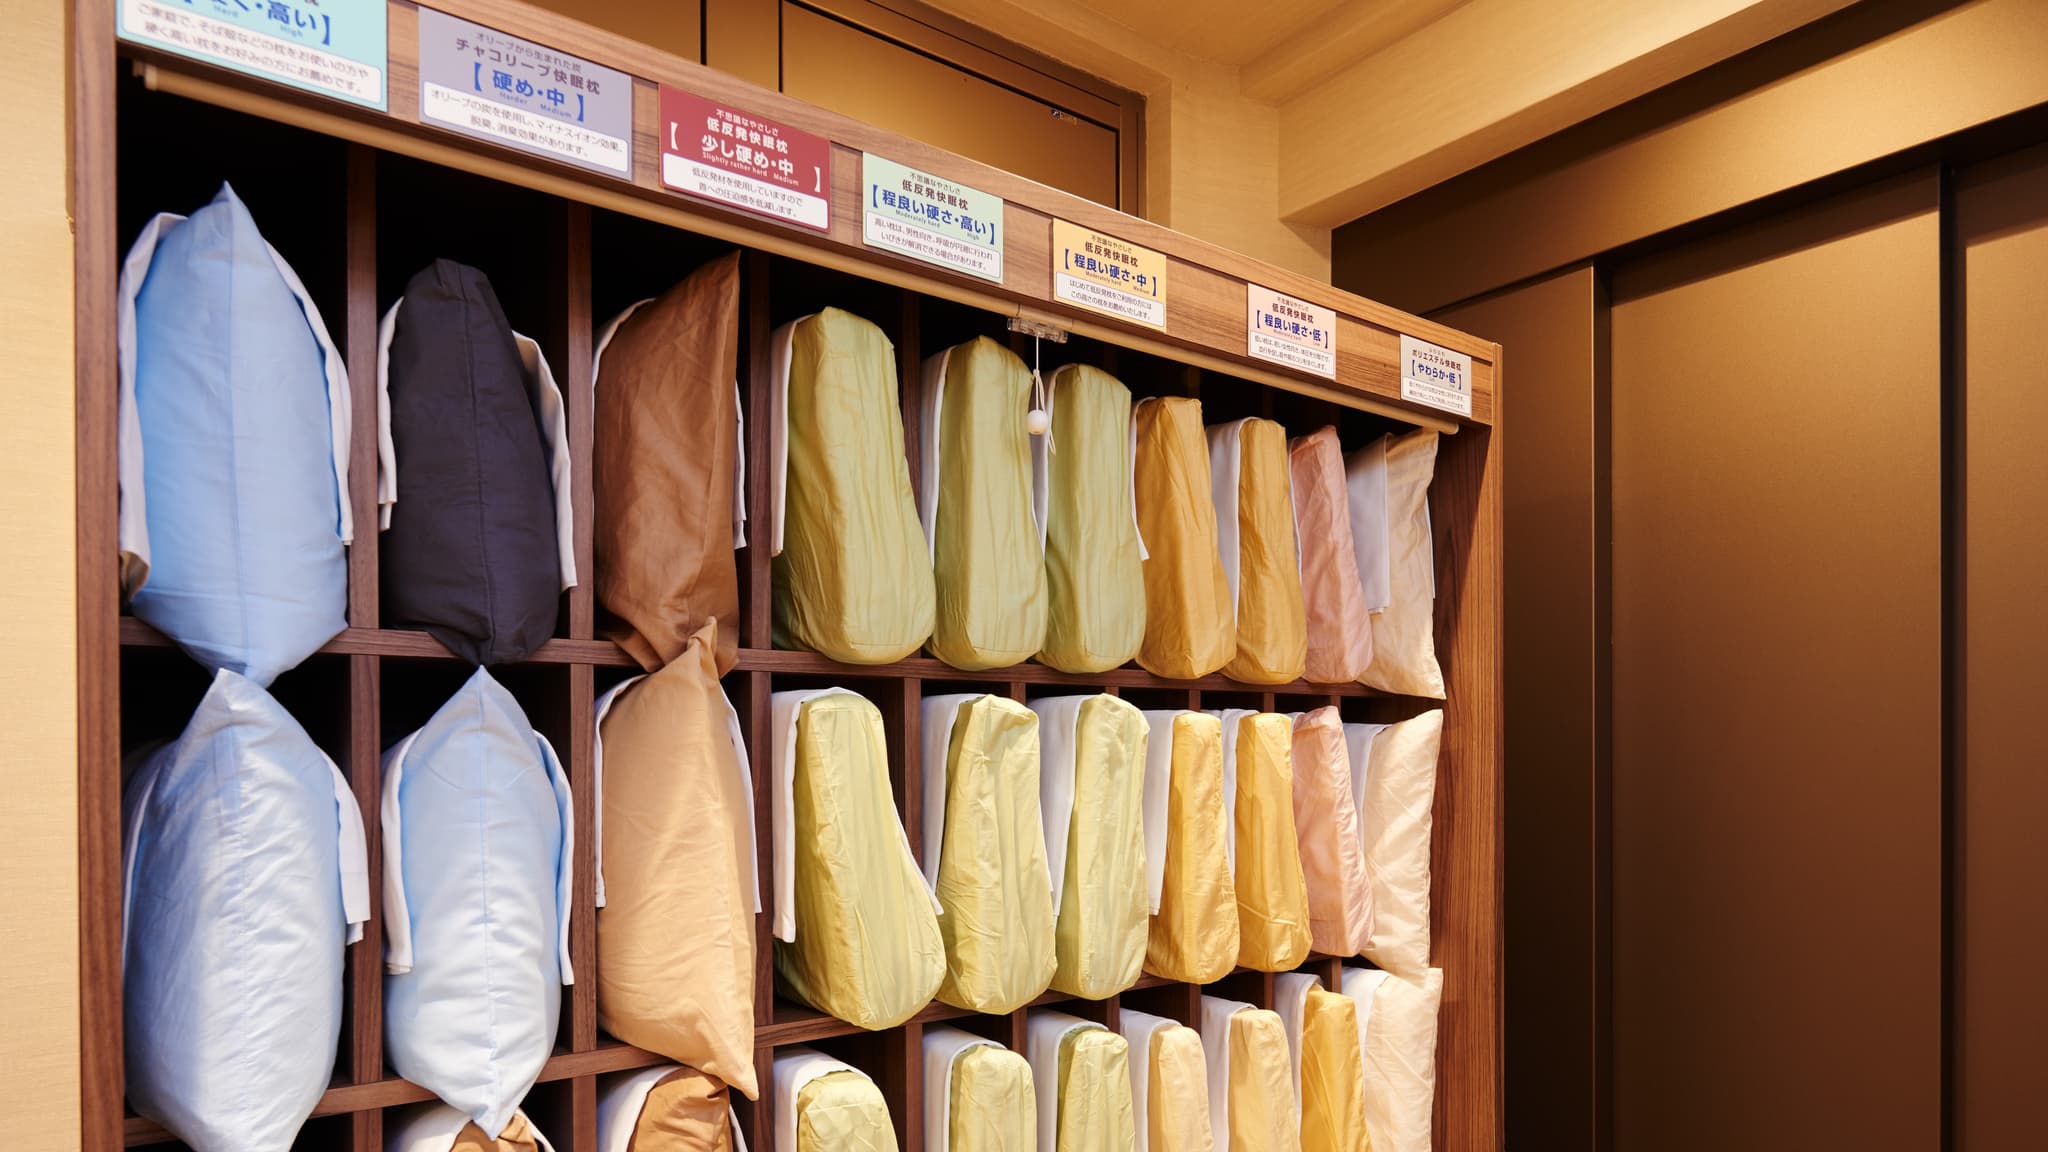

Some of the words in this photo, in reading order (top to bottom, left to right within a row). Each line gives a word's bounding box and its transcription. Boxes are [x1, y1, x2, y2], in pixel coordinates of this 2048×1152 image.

[476, 31, 582, 74] オリーブから生まれた炭
[540, 103, 572, 119] Medium
[716, 108, 779, 137] 不思議なやさしさ
[707, 116, 788, 155] 低反発快眠枕
[691, 166, 804, 207] 低反発材を使用していますので
[702, 151, 729, 167] Slightly
[730, 158, 751, 172] rather
[752, 165, 768, 177] hard
[773, 172, 800, 186] Medium
[910, 172, 961, 196] 不思議なやさしさ
[699, 182, 798, 218] 首への圧迫感を低減します。
[902, 178, 969, 211] 低反発快眠枕
[872, 184, 995, 246] 【程良い硬さ・高い】
[1064, 247, 1157, 297] 【程良い硬さ・中】
[1085, 241, 1139, 268] 低反発快眠枕
[1256, 309, 1329, 350] 【程良い硬さ・低】
